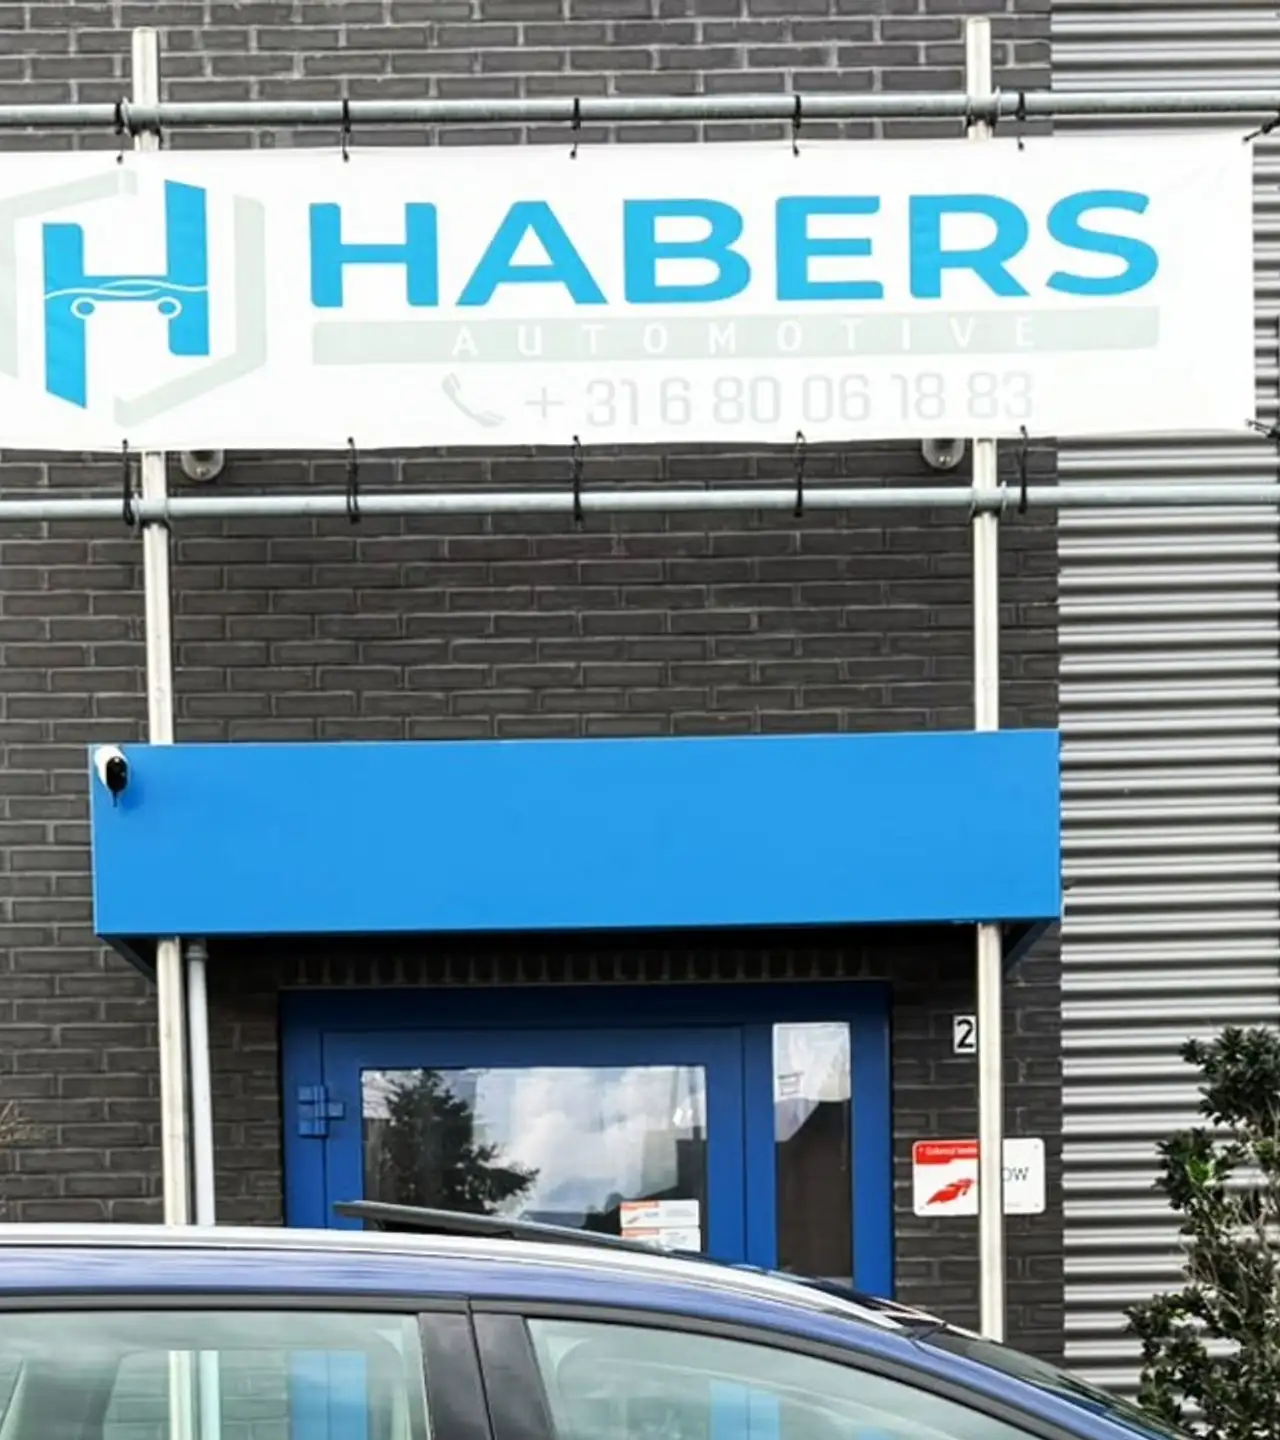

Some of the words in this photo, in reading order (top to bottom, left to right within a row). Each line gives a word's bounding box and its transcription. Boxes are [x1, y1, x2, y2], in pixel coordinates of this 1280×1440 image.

[309, 189, 1159, 308] HABERS
[452, 316, 1035, 356] AUTOMOTIVE
[660, 377, 692, 426] 6
[713, 376, 781, 425] 80
[803, 374, 870, 422] 06
[889, 372, 946, 420] 18
[967, 370, 1034, 420] 83
[956, 1018, 975, 1049] 2
